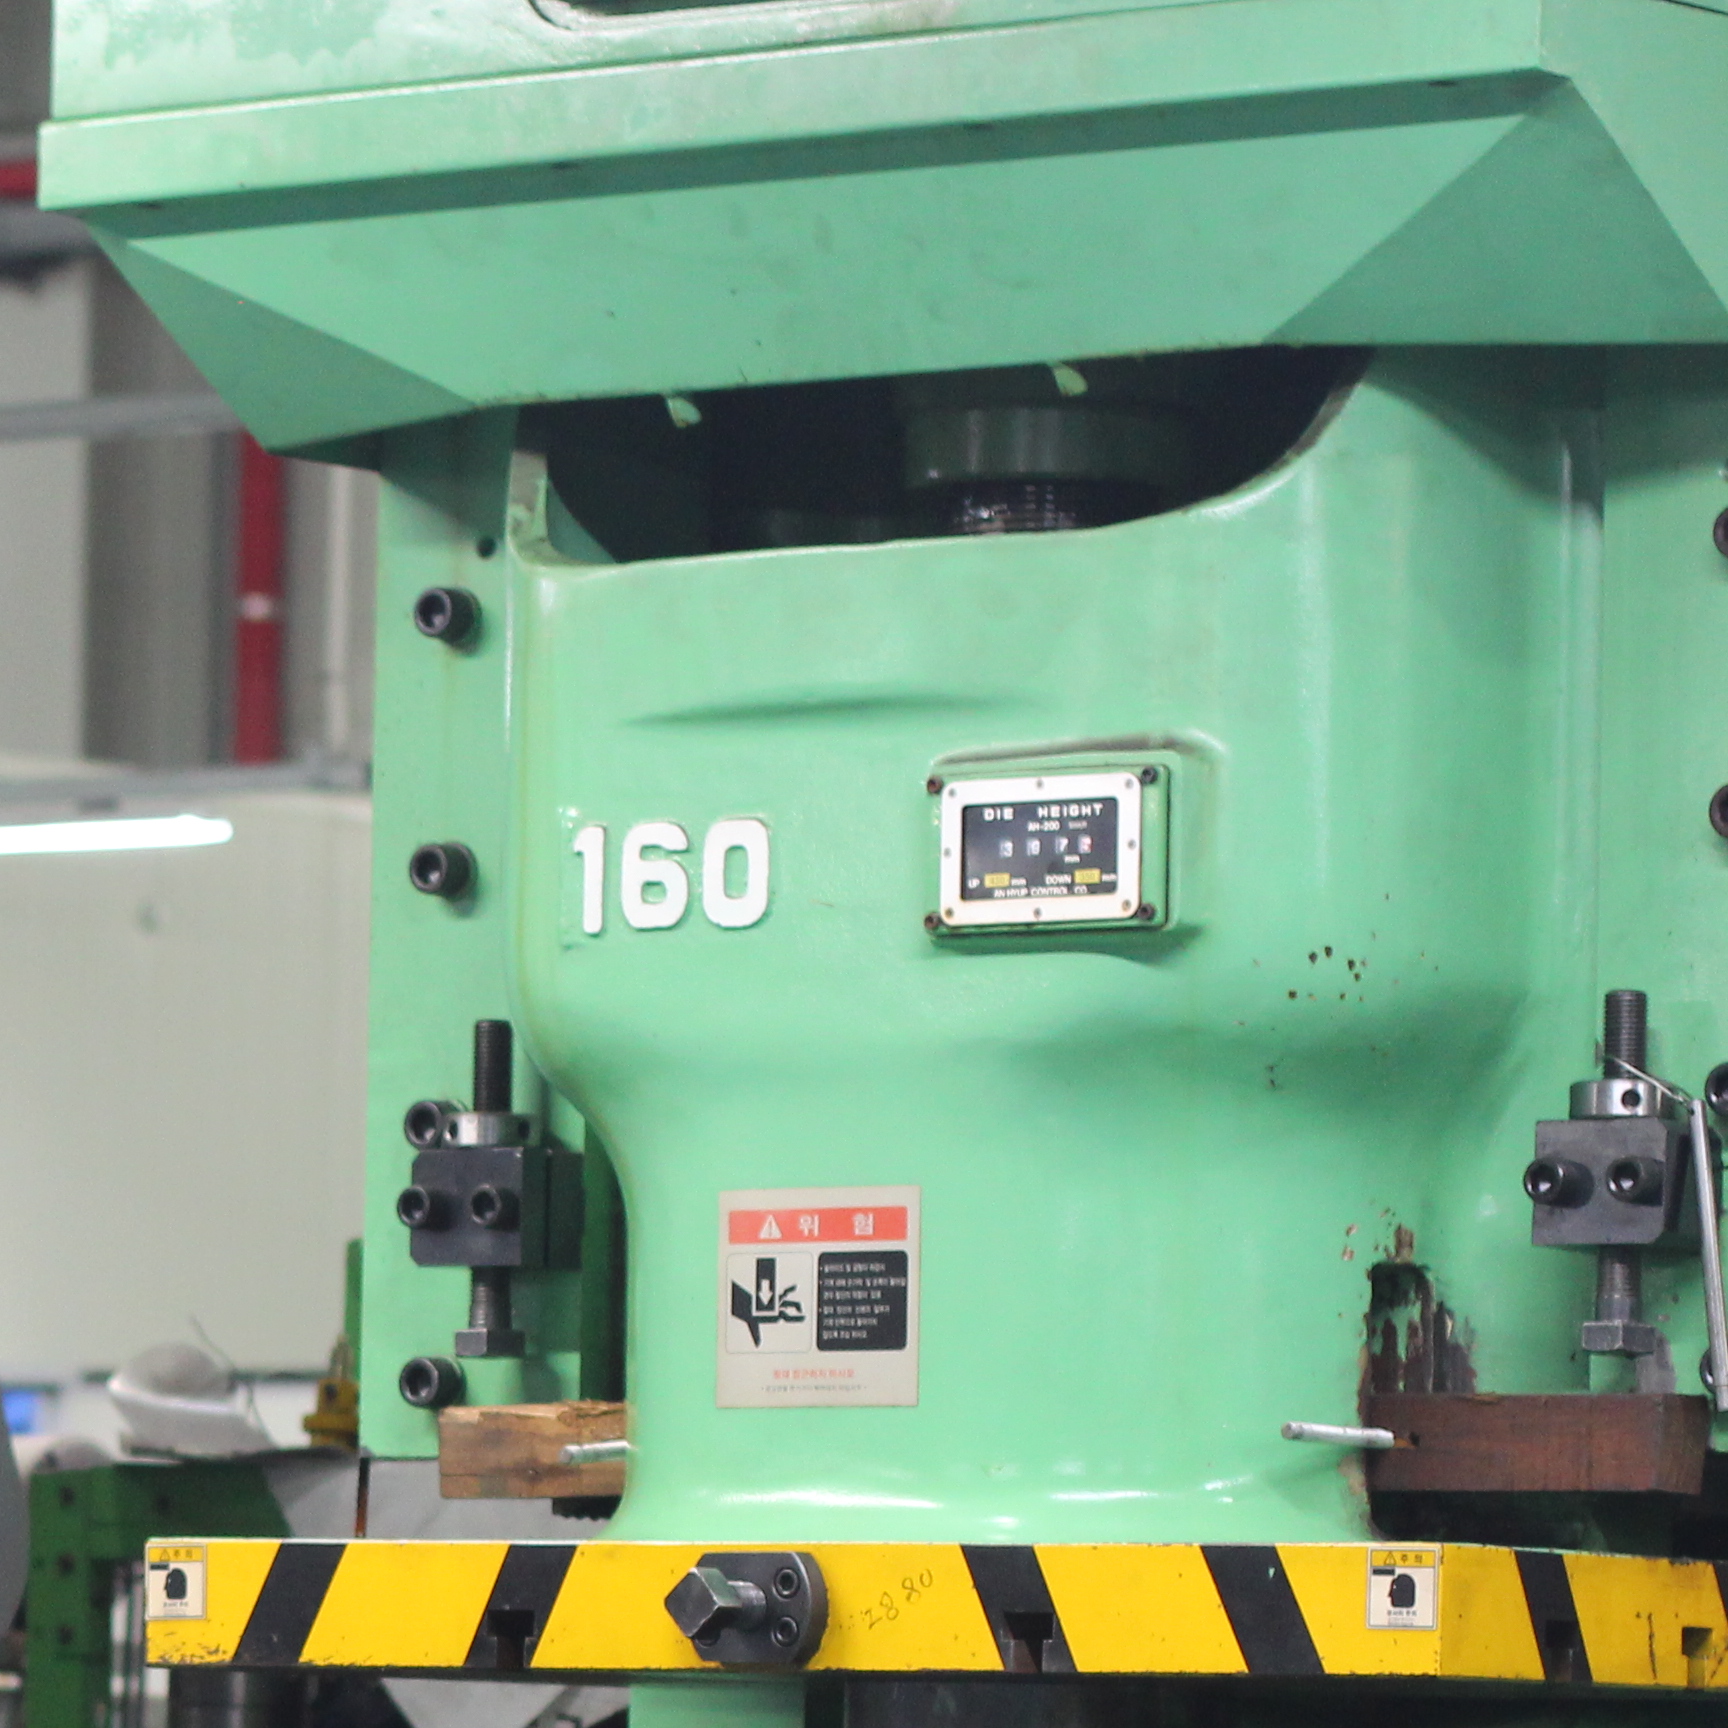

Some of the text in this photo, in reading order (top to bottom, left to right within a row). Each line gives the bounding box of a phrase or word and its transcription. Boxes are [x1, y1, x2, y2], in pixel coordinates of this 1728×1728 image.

[984, 803, 1103, 821] DIE HEIGHT
[1028, 822, 1060, 832] AH-200
[573, 819, 770, 935] 160
[968, 877, 981, 889] UP
[1045, 874, 1072, 885] DOWN
